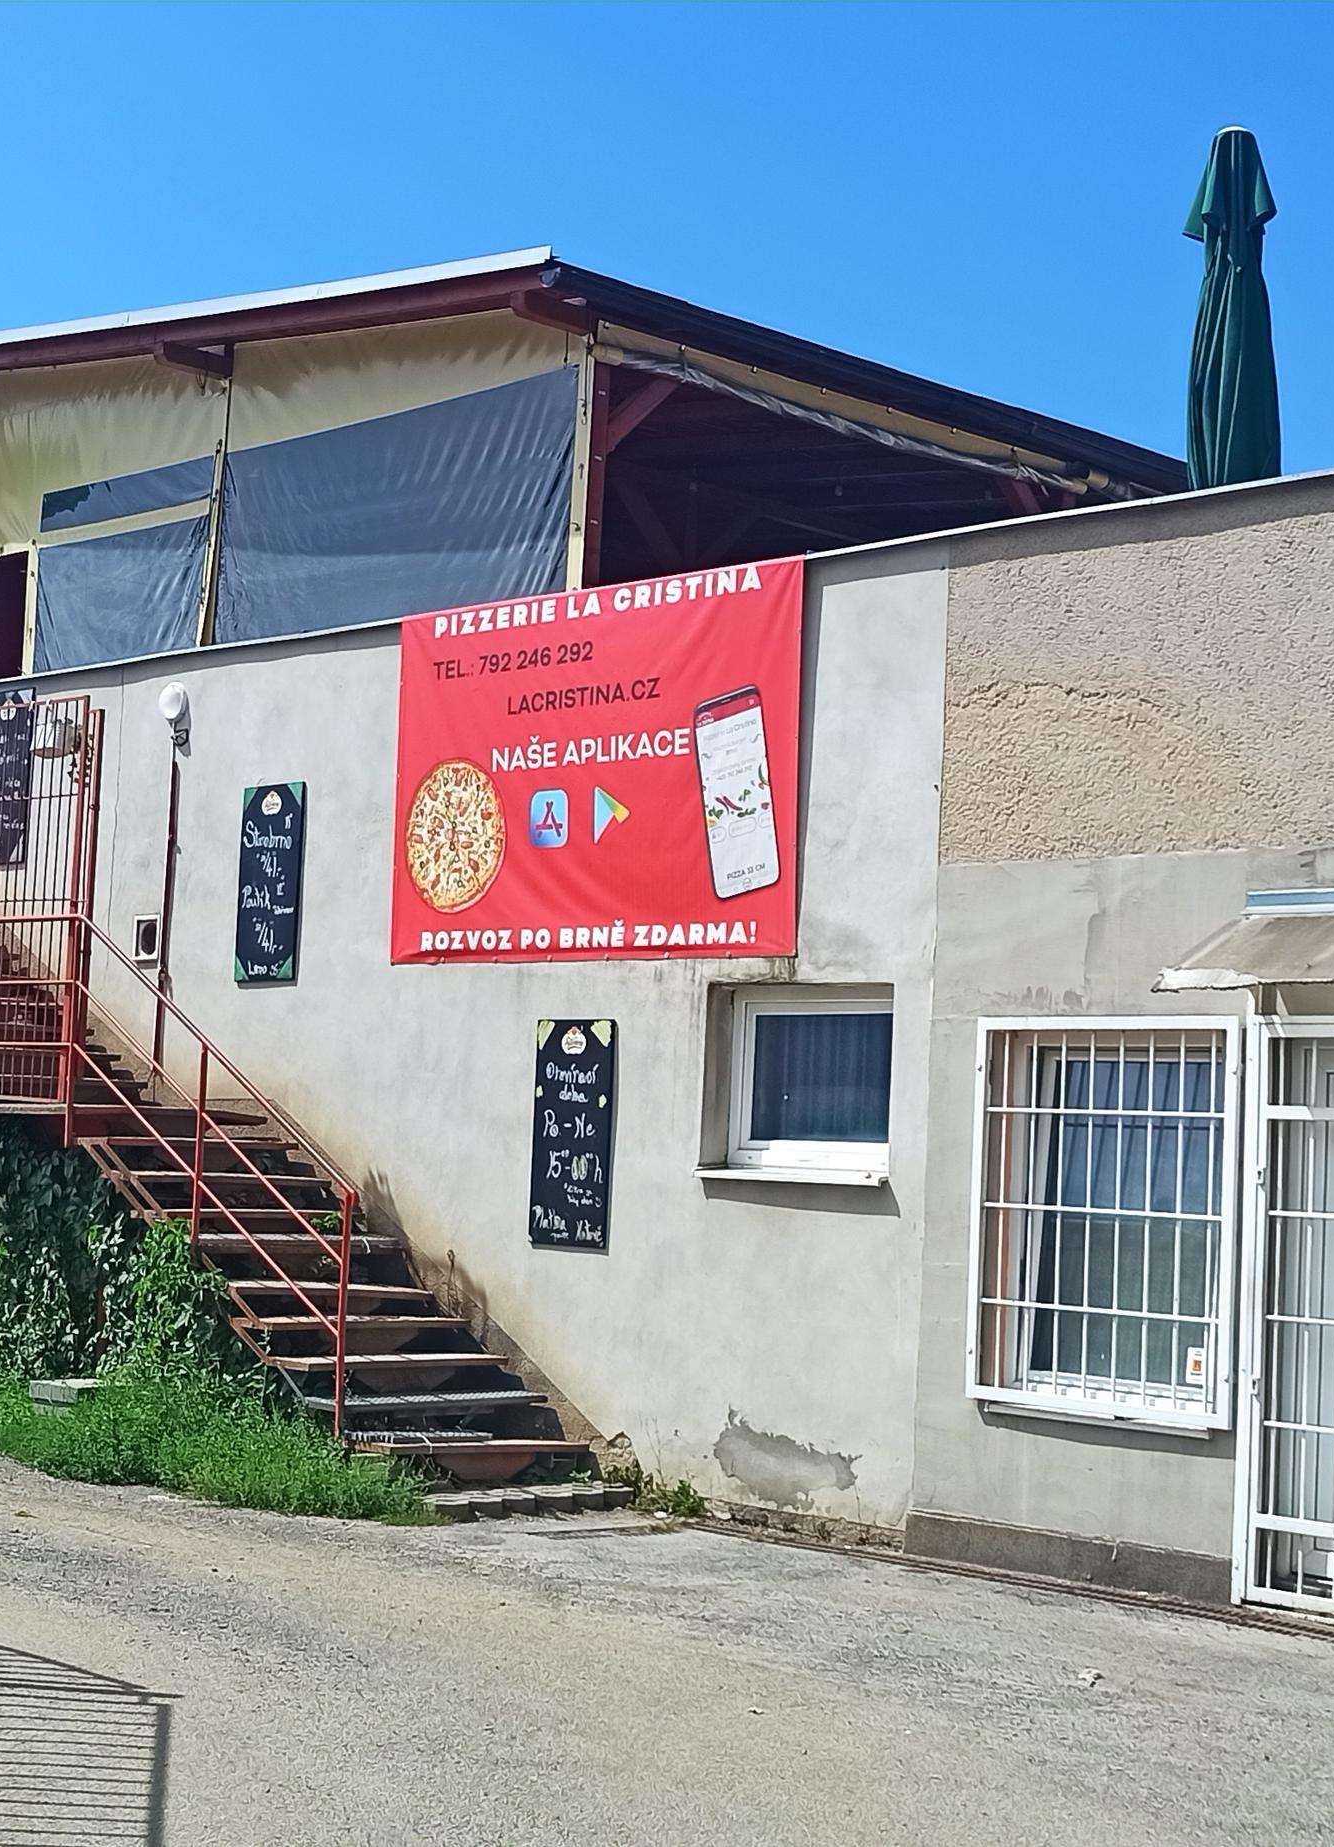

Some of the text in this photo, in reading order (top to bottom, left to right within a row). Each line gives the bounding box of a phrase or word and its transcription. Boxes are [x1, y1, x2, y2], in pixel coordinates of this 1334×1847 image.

[434, 567, 762, 640] PIZZERIE LA CRISTINA
[479, 651, 511, 675] 792
[516, 647, 551, 669] 246
[557, 641, 593, 664] 292
[507, 678, 661, 715] LACRISTINA.CZ
[491, 736, 557, 772] NAŠE
[562, 728, 690, 765] APLIKACE
[420, 920, 757, 951] ROZVOZ PO BRNĚ ZDARMA!
